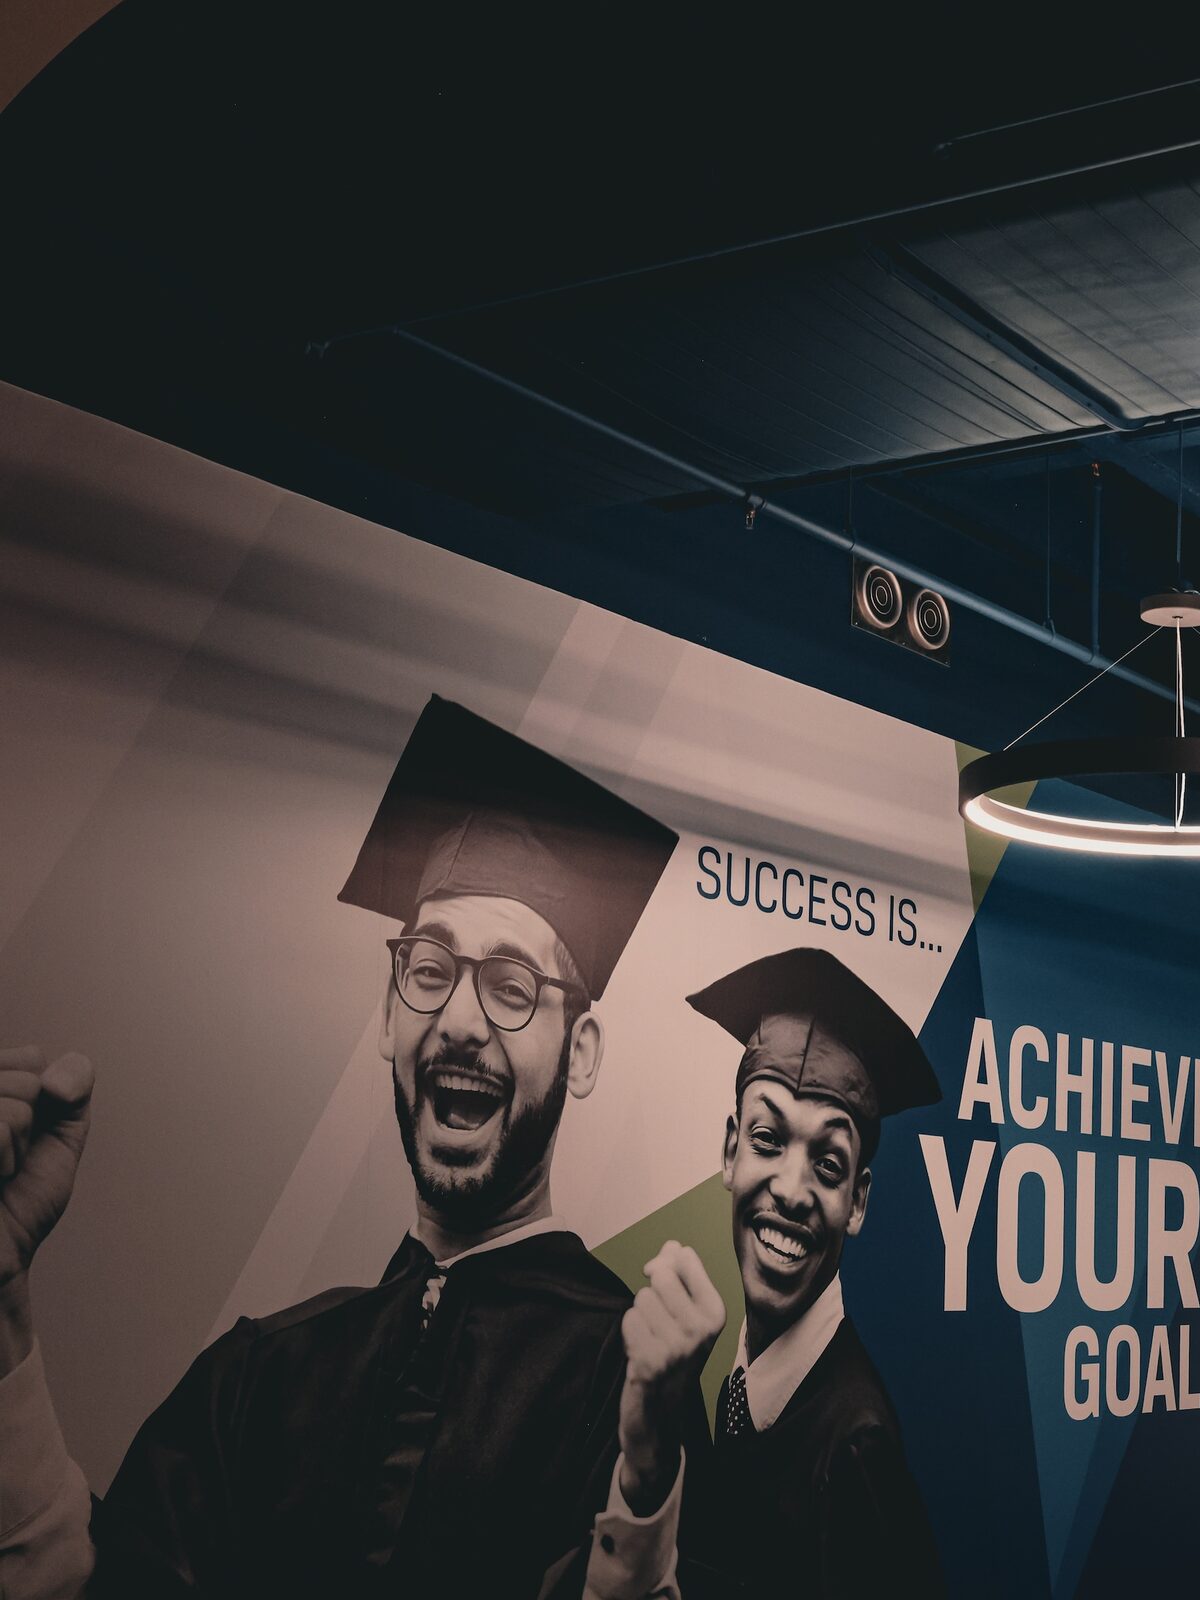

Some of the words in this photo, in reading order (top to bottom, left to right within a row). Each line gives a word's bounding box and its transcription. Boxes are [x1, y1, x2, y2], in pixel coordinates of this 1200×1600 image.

[696, 846, 876, 937] SUCCESS
[888, 895, 942, 953] IS...
[917, 1133, 1200, 1314] YOUR
